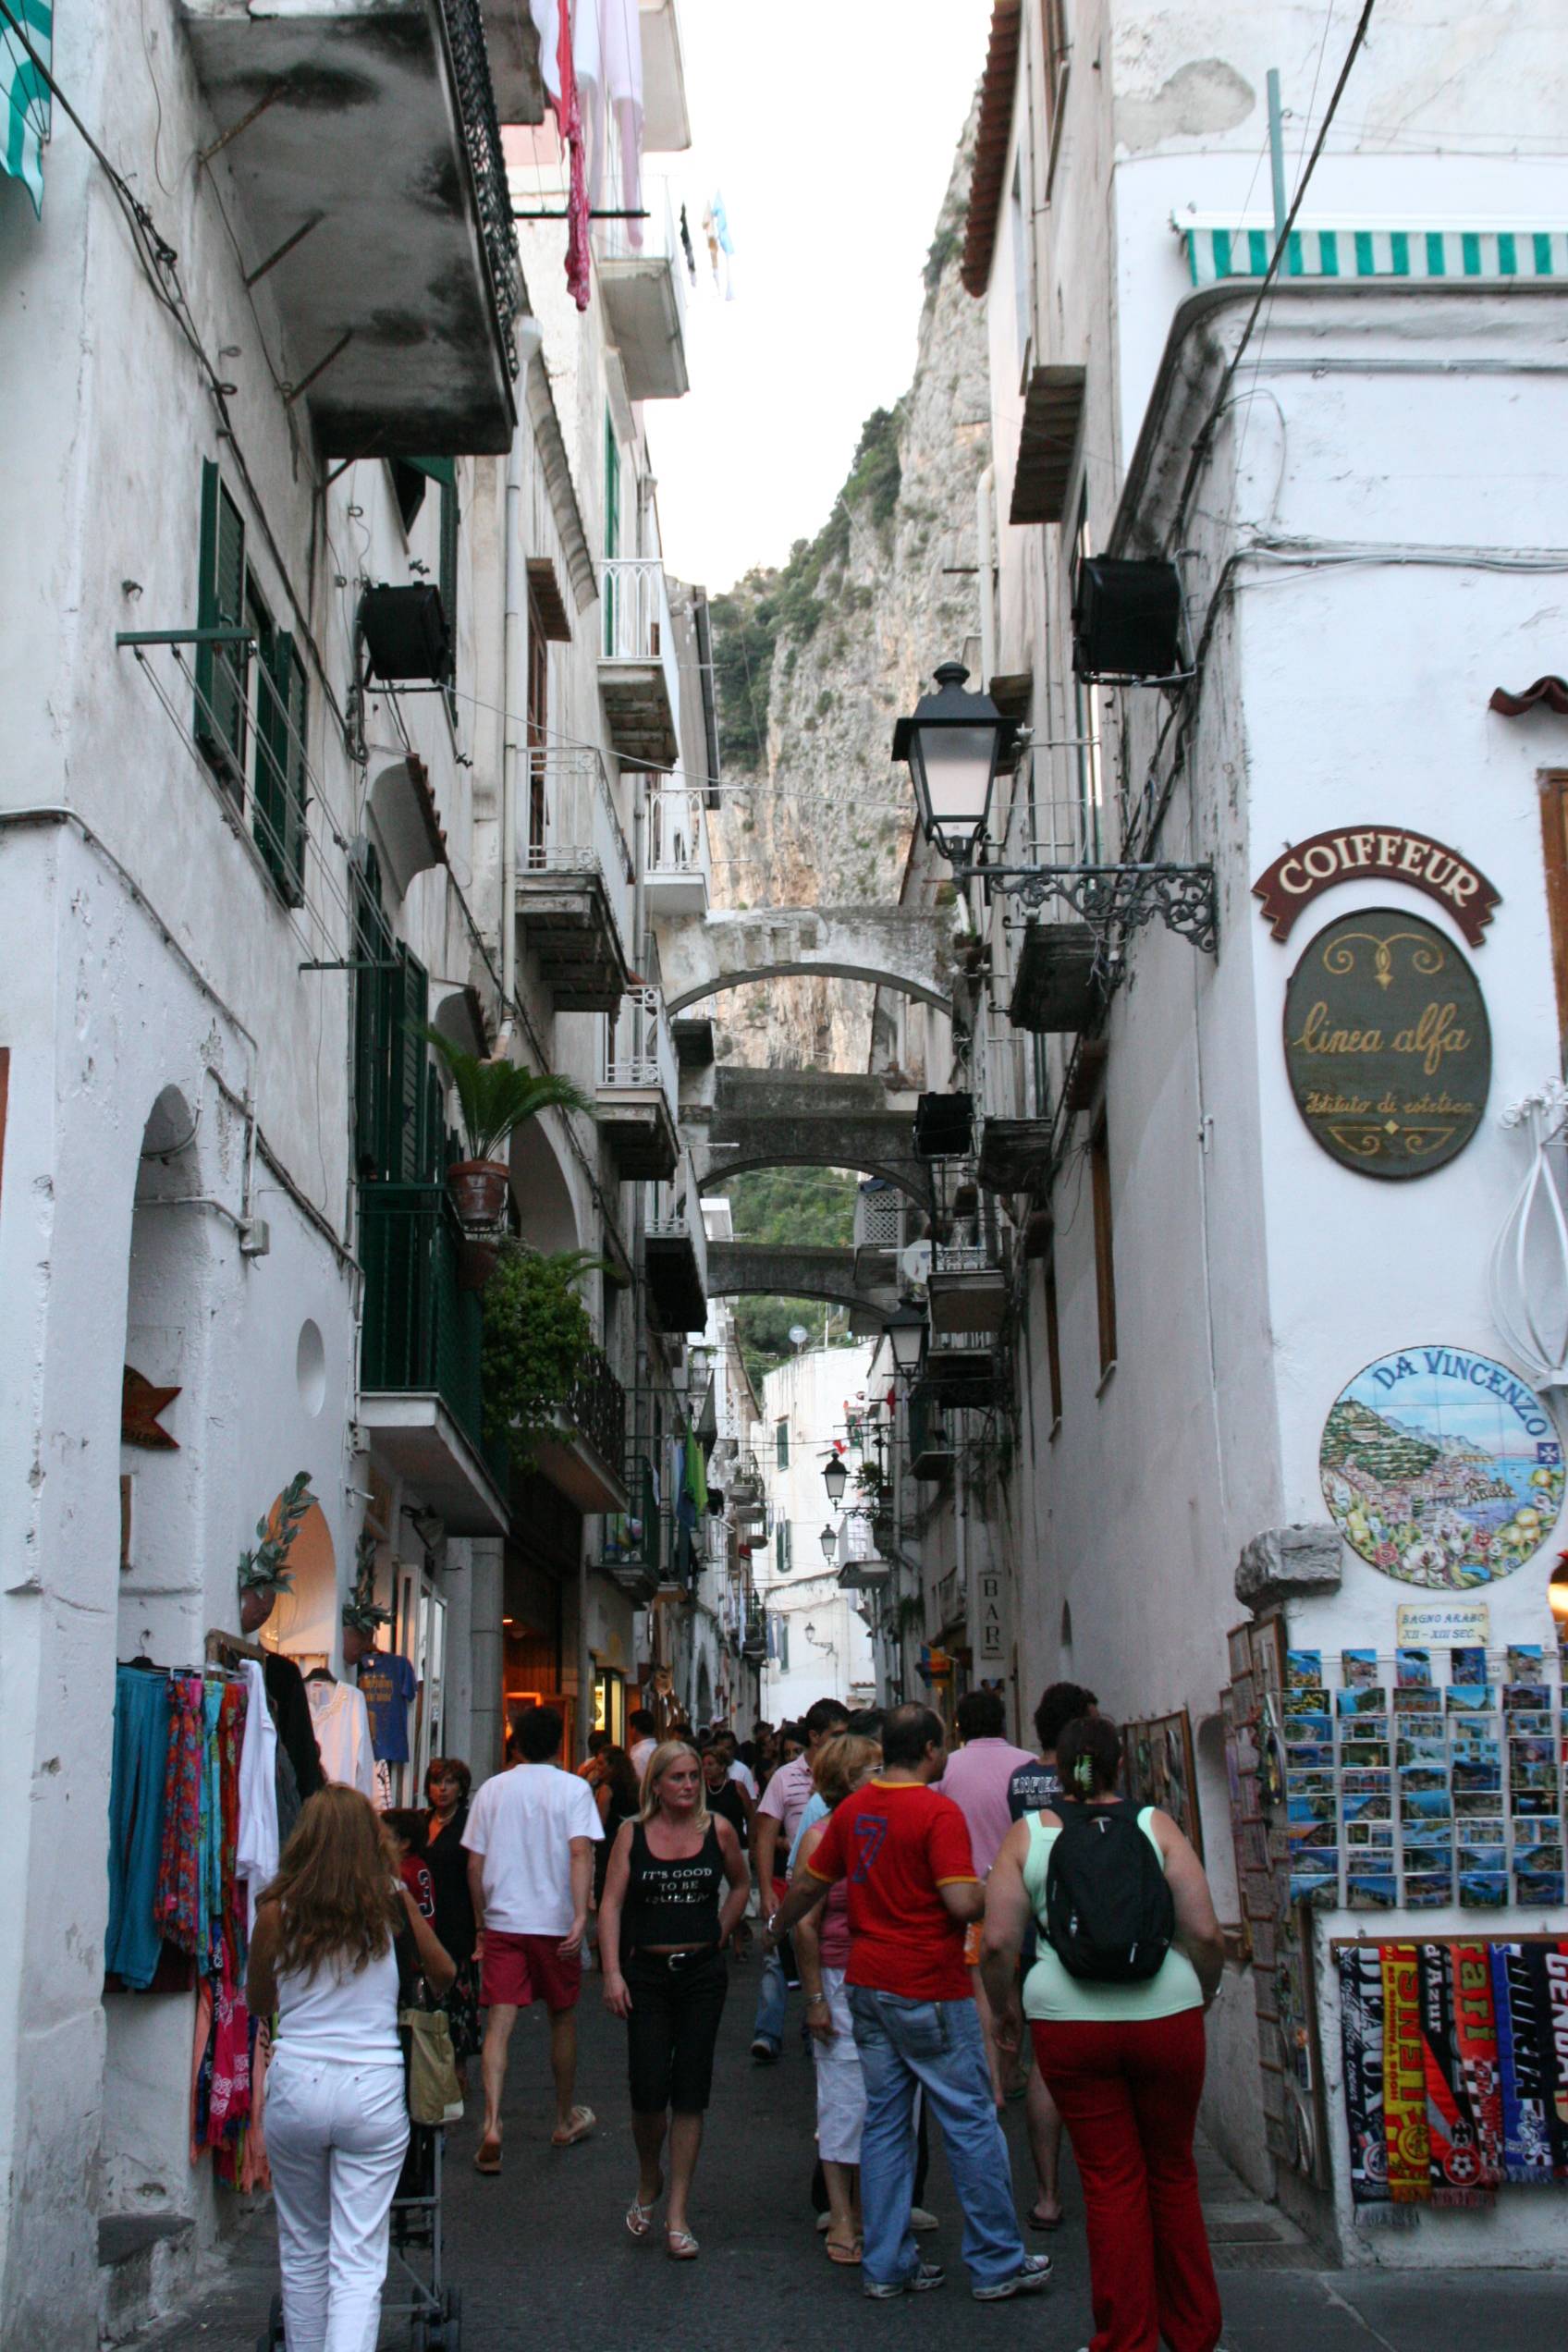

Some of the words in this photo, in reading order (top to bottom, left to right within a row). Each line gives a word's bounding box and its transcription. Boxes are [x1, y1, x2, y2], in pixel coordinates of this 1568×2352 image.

[1280, 832, 1478, 908] COIFFEUR
[1292, 1000, 1384, 1054] linea
[1390, 1002, 1471, 1076] alfa
[1378, 1091, 1398, 1113] di
[1372, 1355, 1418, 1390] DA
[1423, 1350, 1549, 1437] VINCENZO
[983, 1579, 999, 1644] BAR
[642, 1870, 668, 1880] IT'S
[672, 1868, 713, 1879] GOOD
[851, 1814, 888, 1883] 7
[658, 1881, 678, 1892] TO
[681, 1880, 699, 1890] BE
